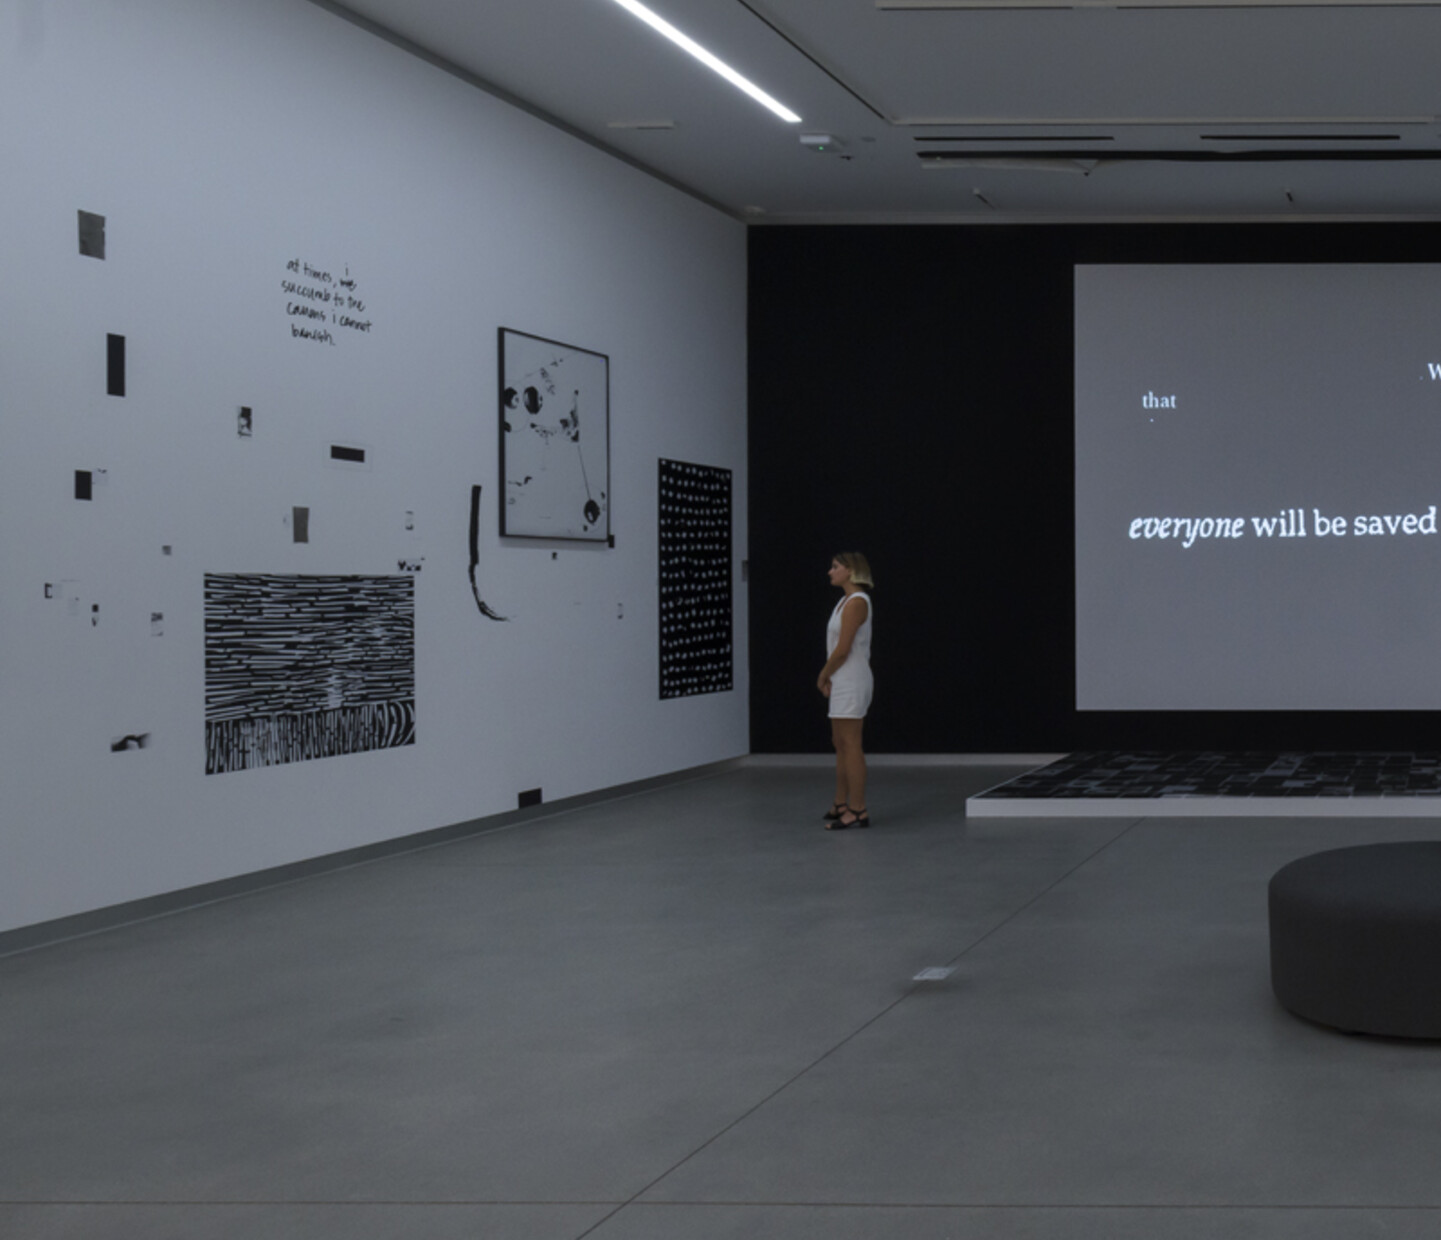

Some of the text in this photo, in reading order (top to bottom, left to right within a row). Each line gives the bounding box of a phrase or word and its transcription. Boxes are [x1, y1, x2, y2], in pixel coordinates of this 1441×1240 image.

[286, 259, 299, 273] at
[281, 280, 331, 302] succumb
[333, 292, 345, 307] to
[347, 296, 366, 312] the
[340, 315, 372, 333] cannot
[1142, 390, 1176, 409] that
[1128, 513, 1245, 549] everyone
[1251, 507, 1307, 538] will
[1313, 507, 1348, 537] be
[1353, 506, 1438, 537] saved
